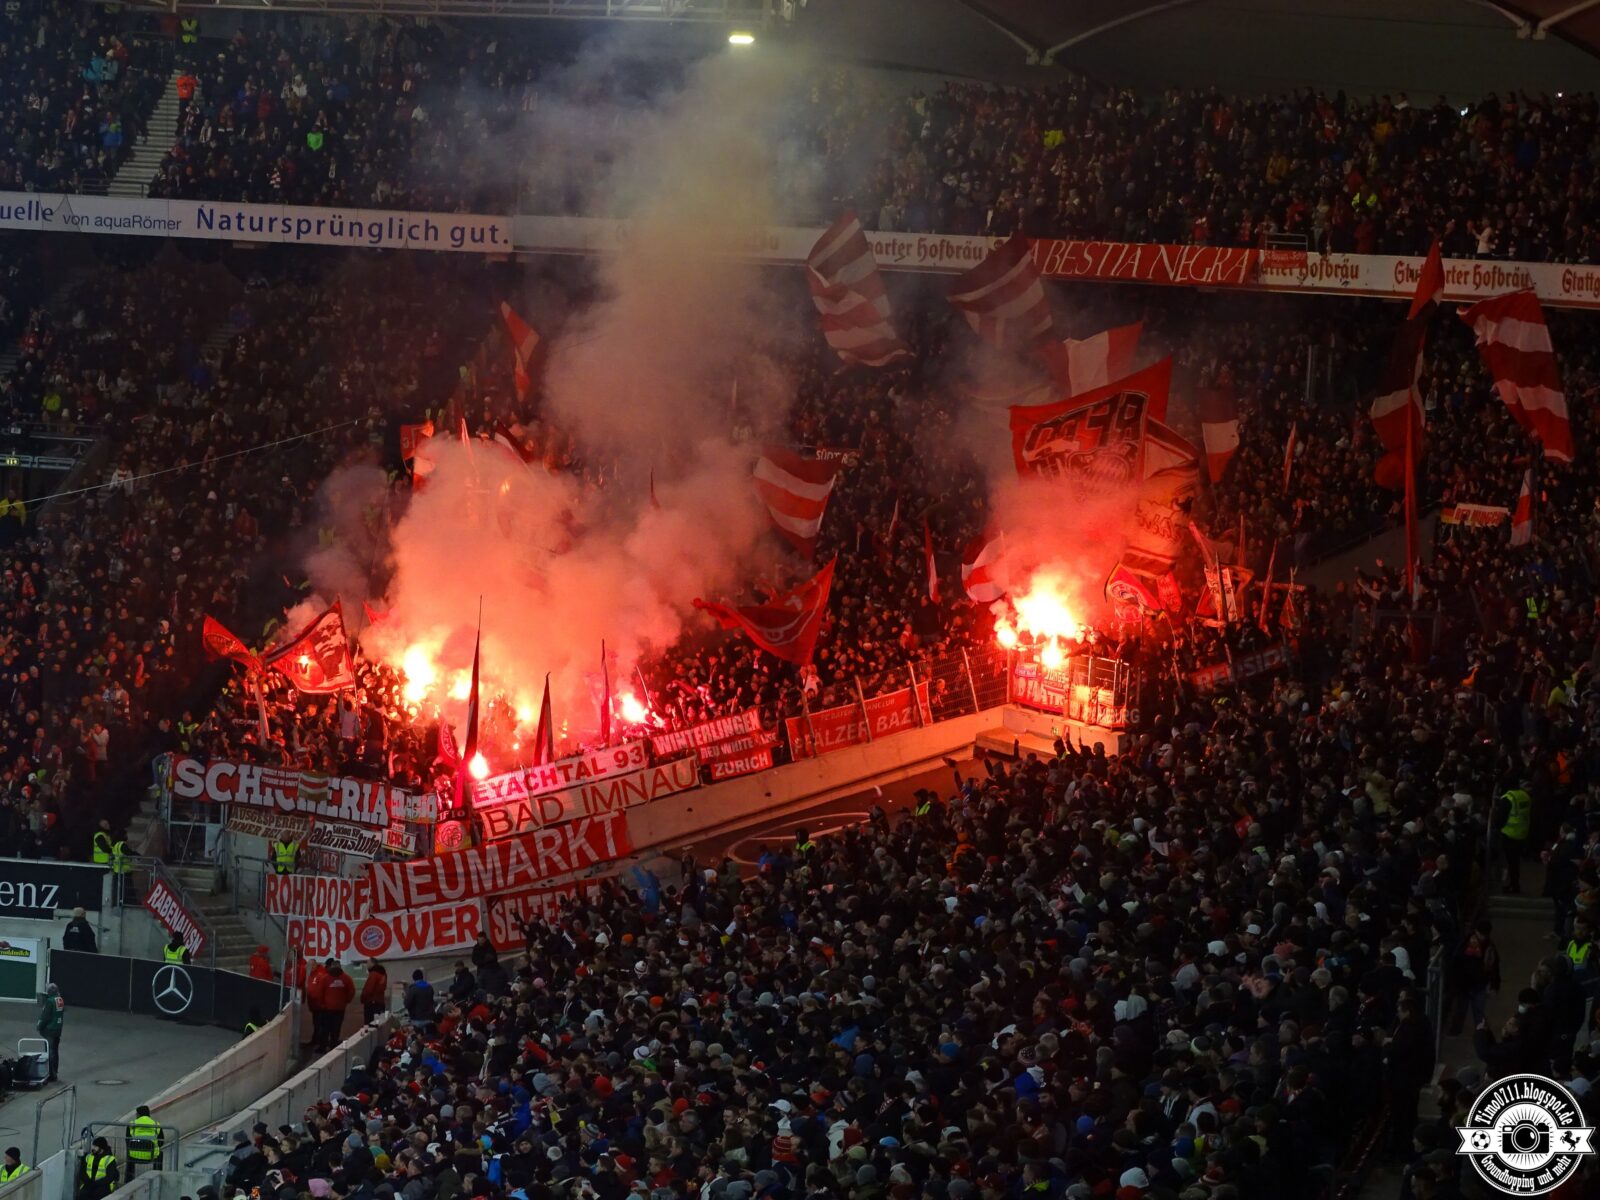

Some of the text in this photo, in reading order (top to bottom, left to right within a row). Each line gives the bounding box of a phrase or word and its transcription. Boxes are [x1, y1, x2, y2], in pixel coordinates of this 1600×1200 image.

[63, 214, 89, 226] von
[94, 214, 182, 231] aquaRömer
[197, 207, 439, 244] Natursprünglich
[450, 224, 509, 247] gut.
[1042, 240, 1142, 278] BESTIA
[1148, 244, 1250, 284] NEGRA
[654, 710, 760, 756] WINTERLINGEN
[474, 757, 607, 803] EYACHTAL
[612, 746, 644, 769] 93
[485, 796, 564, 836] BAD
[581, 759, 696, 814] IMNAU
[373, 811, 620, 910] NEUMARKT
[0, 880, 60, 909] enz
[266, 874, 369, 920] ROHRDORF
